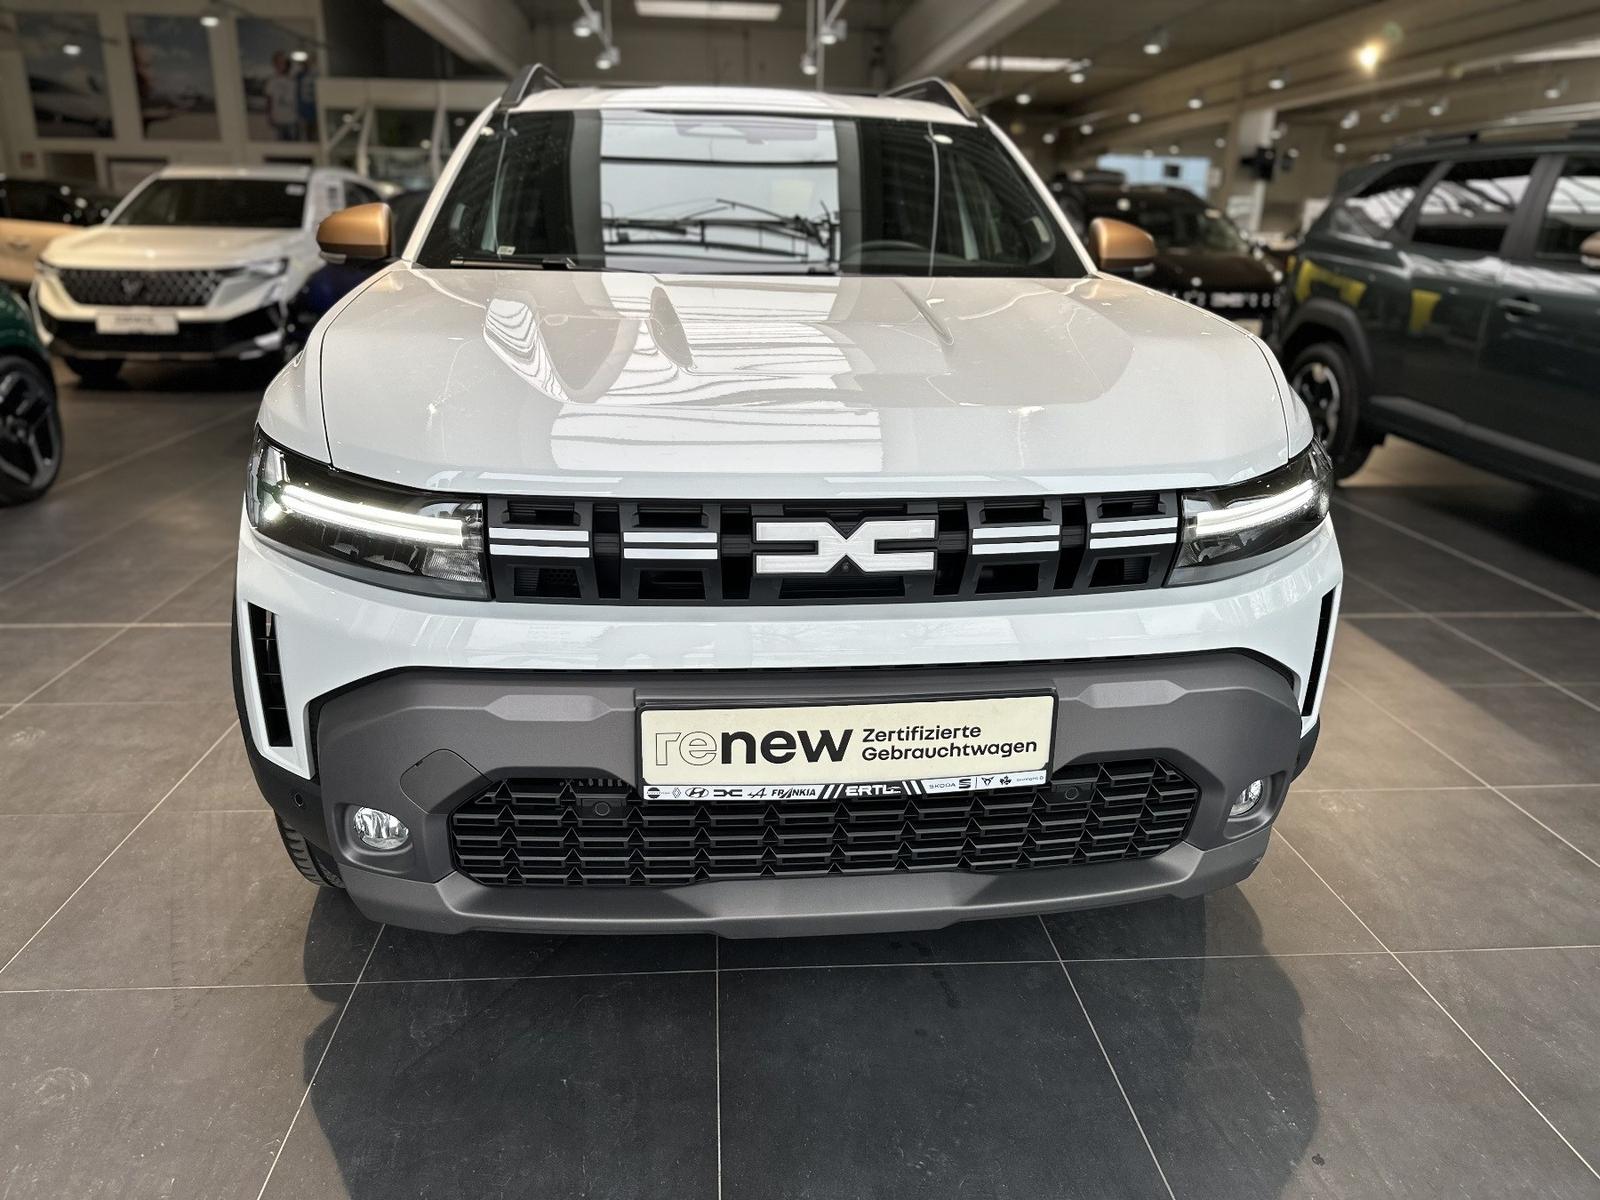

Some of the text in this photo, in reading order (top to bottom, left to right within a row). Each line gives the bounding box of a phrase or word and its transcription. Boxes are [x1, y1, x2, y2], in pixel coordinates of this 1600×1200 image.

[862, 725, 982, 743] Zertifizierte
[656, 729, 854, 766] renew
[862, 741, 1038, 762] Gebrauchtwagen
[771, 787, 816, 799] FRANKIA
